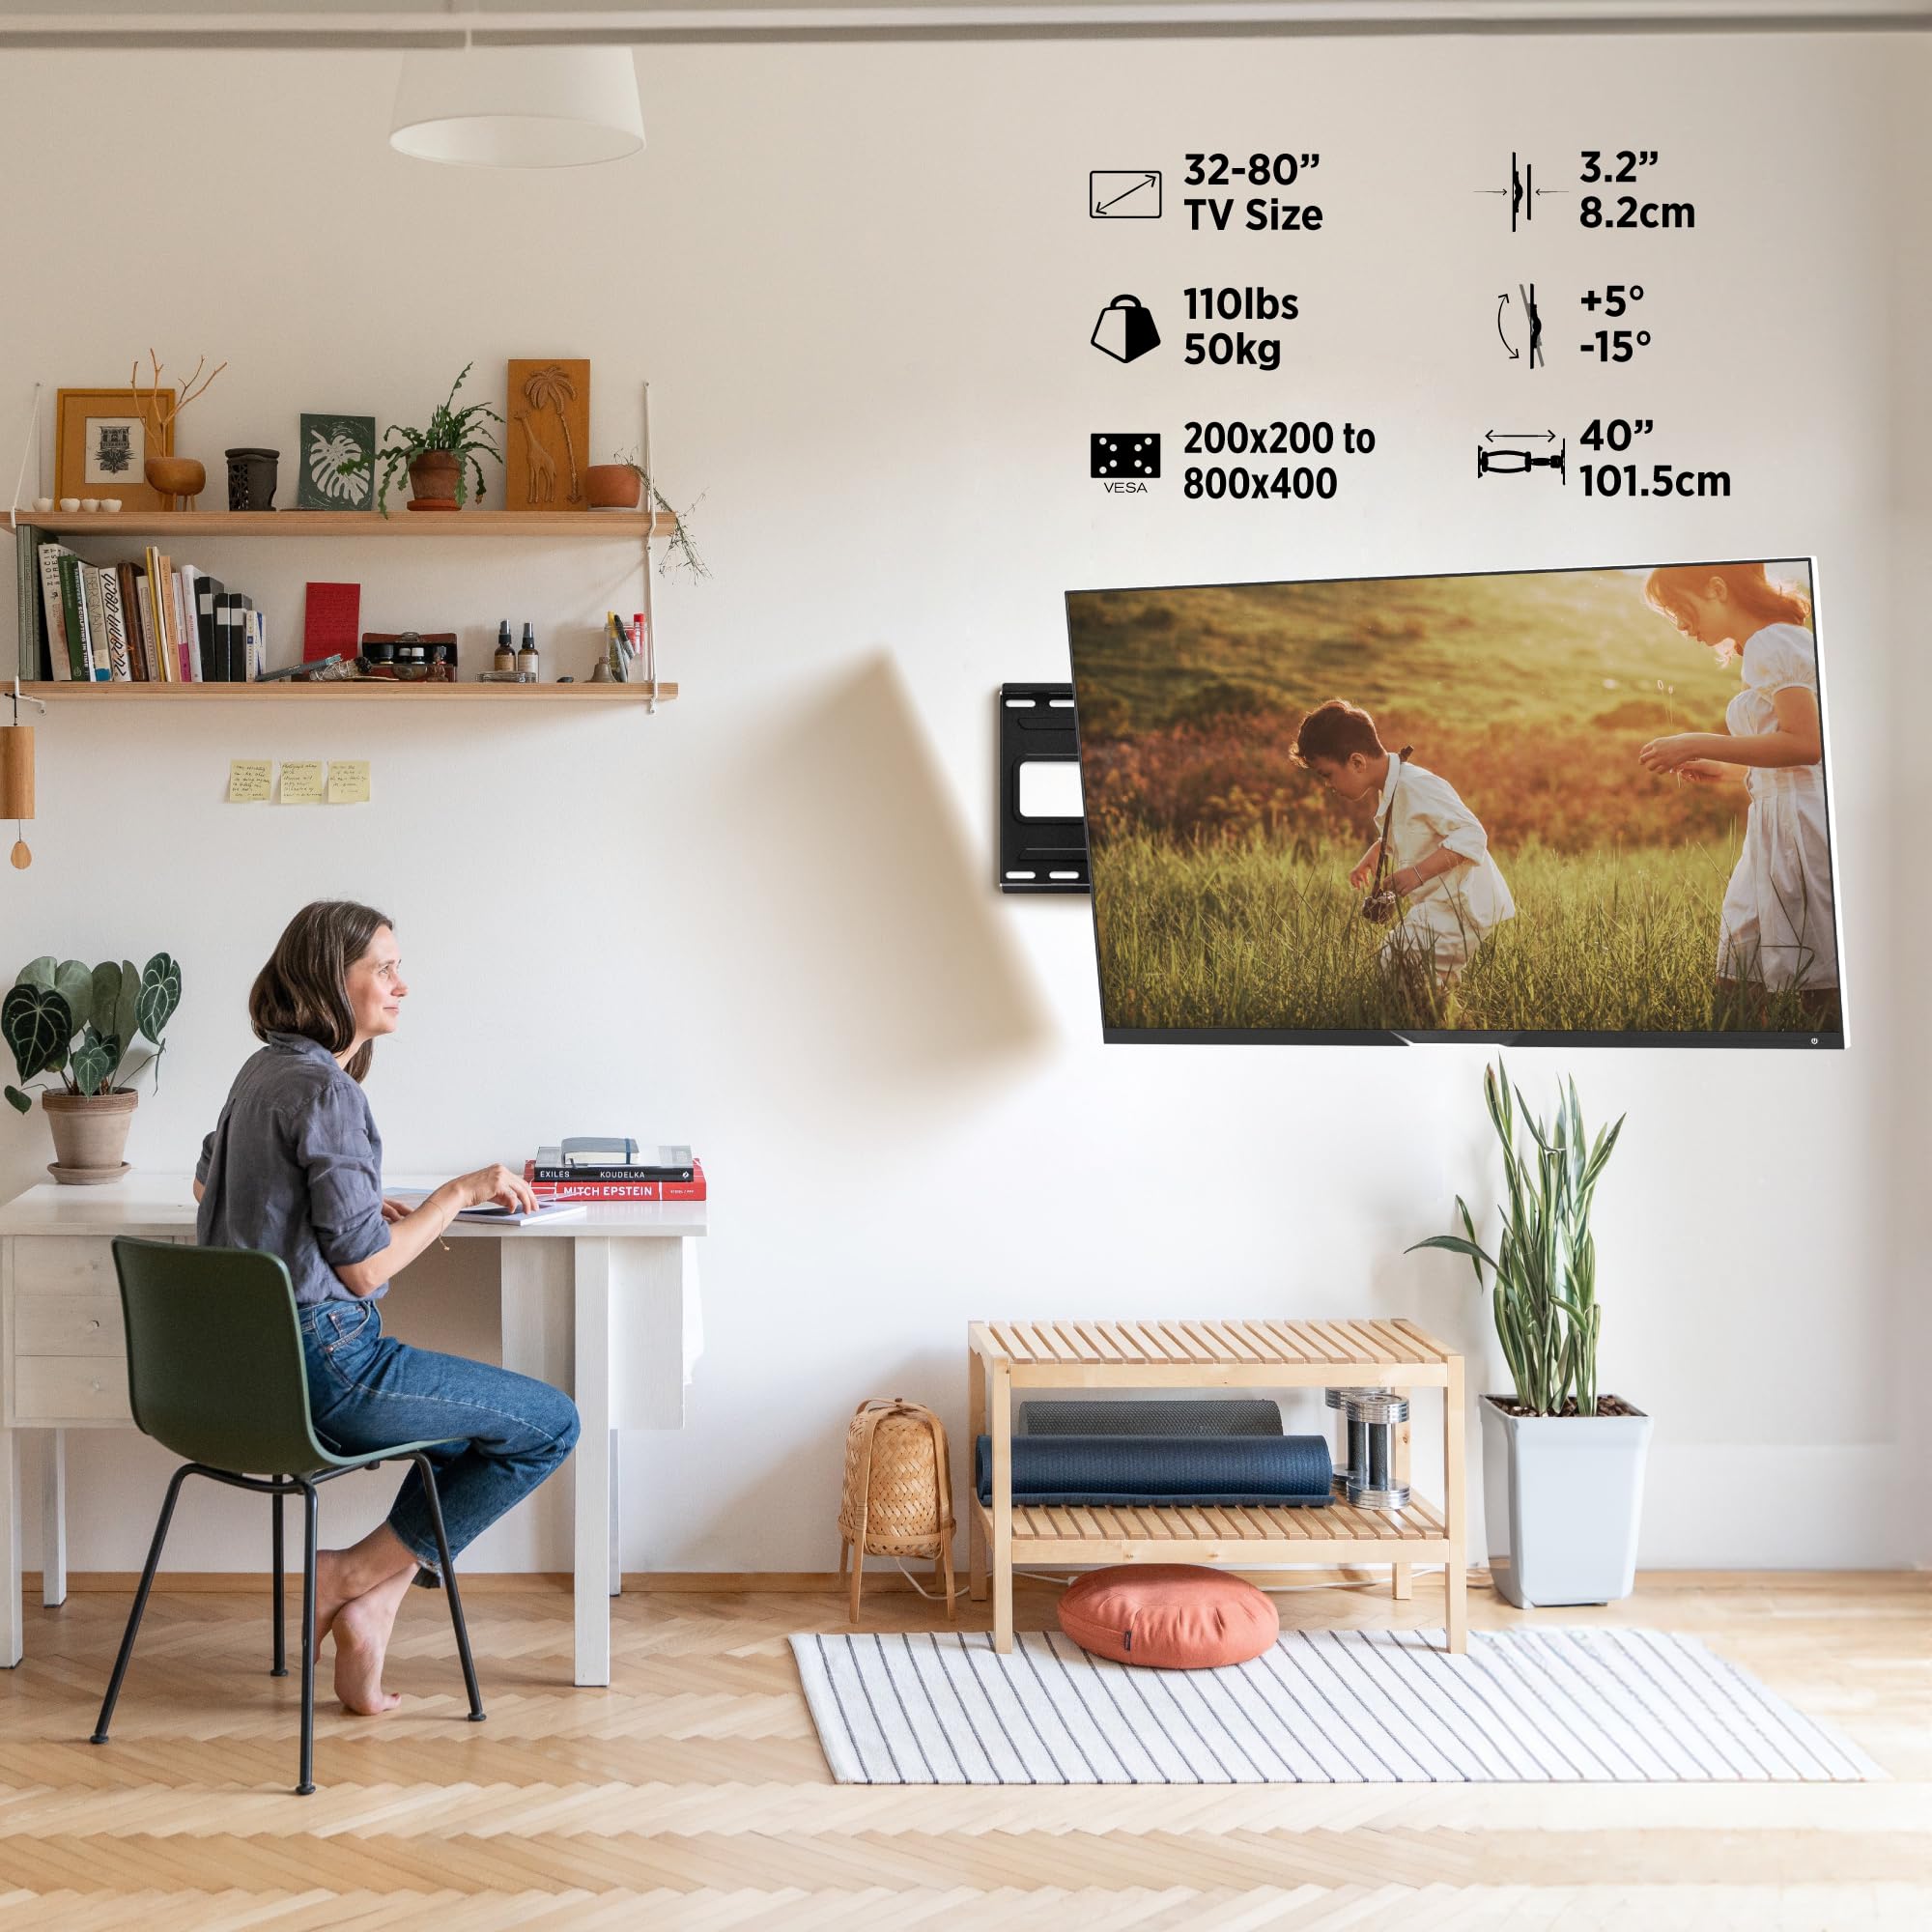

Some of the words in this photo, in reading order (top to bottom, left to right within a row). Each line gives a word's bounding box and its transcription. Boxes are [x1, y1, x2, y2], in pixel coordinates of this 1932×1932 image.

[100, 573, 120, 613] dech
[563, 1186, 600, 1196] MITCH
[603, 1186, 652, 1196] EPSTEIN
